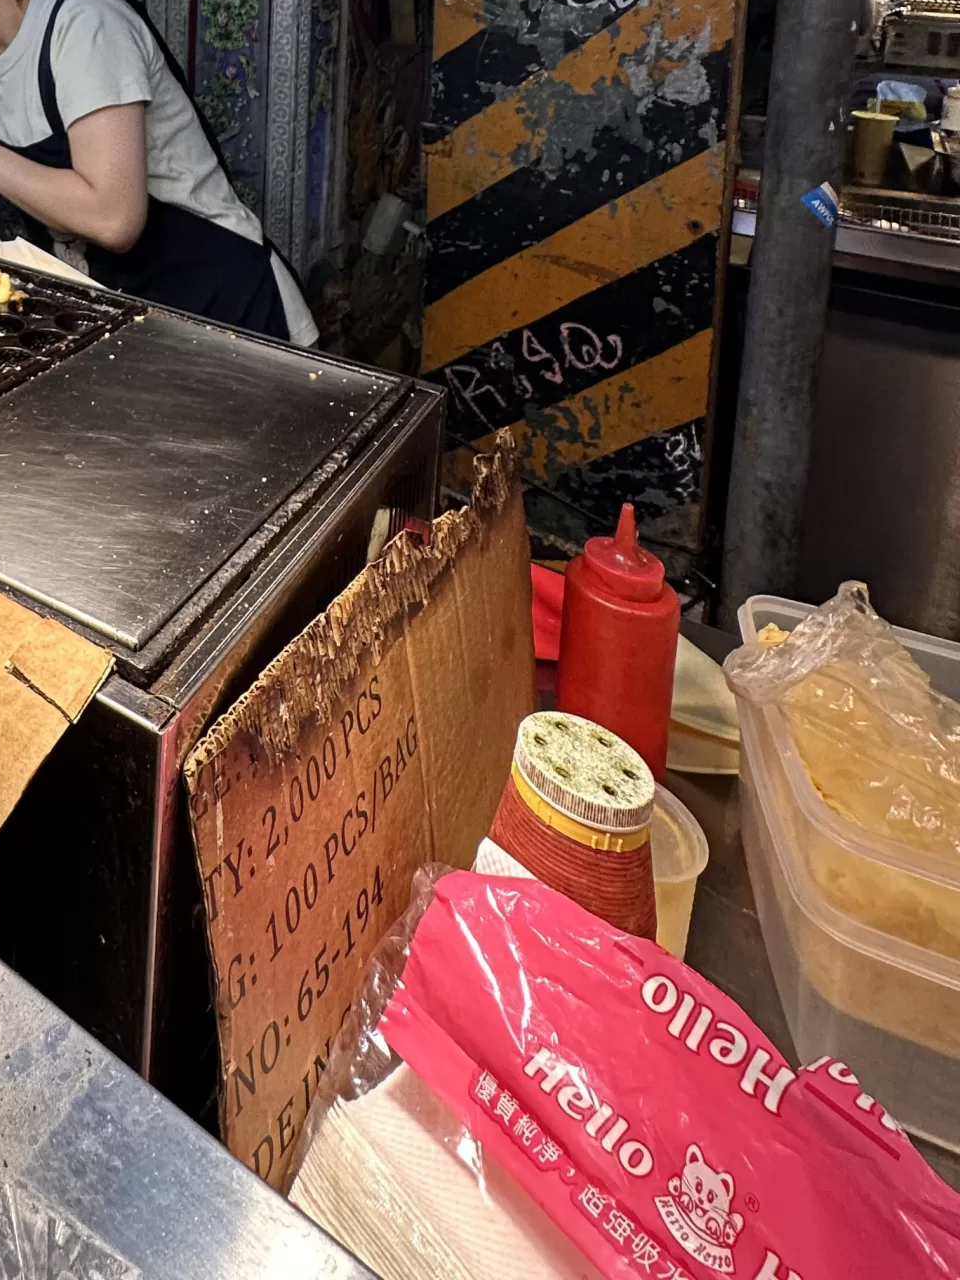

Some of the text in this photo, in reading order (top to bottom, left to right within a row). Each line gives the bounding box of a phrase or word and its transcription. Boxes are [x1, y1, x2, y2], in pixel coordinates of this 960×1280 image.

[262, 735, 337, 860] 2,000
[340, 674, 382, 759] PCS
[219, 715, 418, 1018] G: 100 PCS/BAG
[233, 865, 385, 1118] NO: 65-194
[641, 974, 798, 1115] Hello
[523, 1046, 654, 1177] Hello
